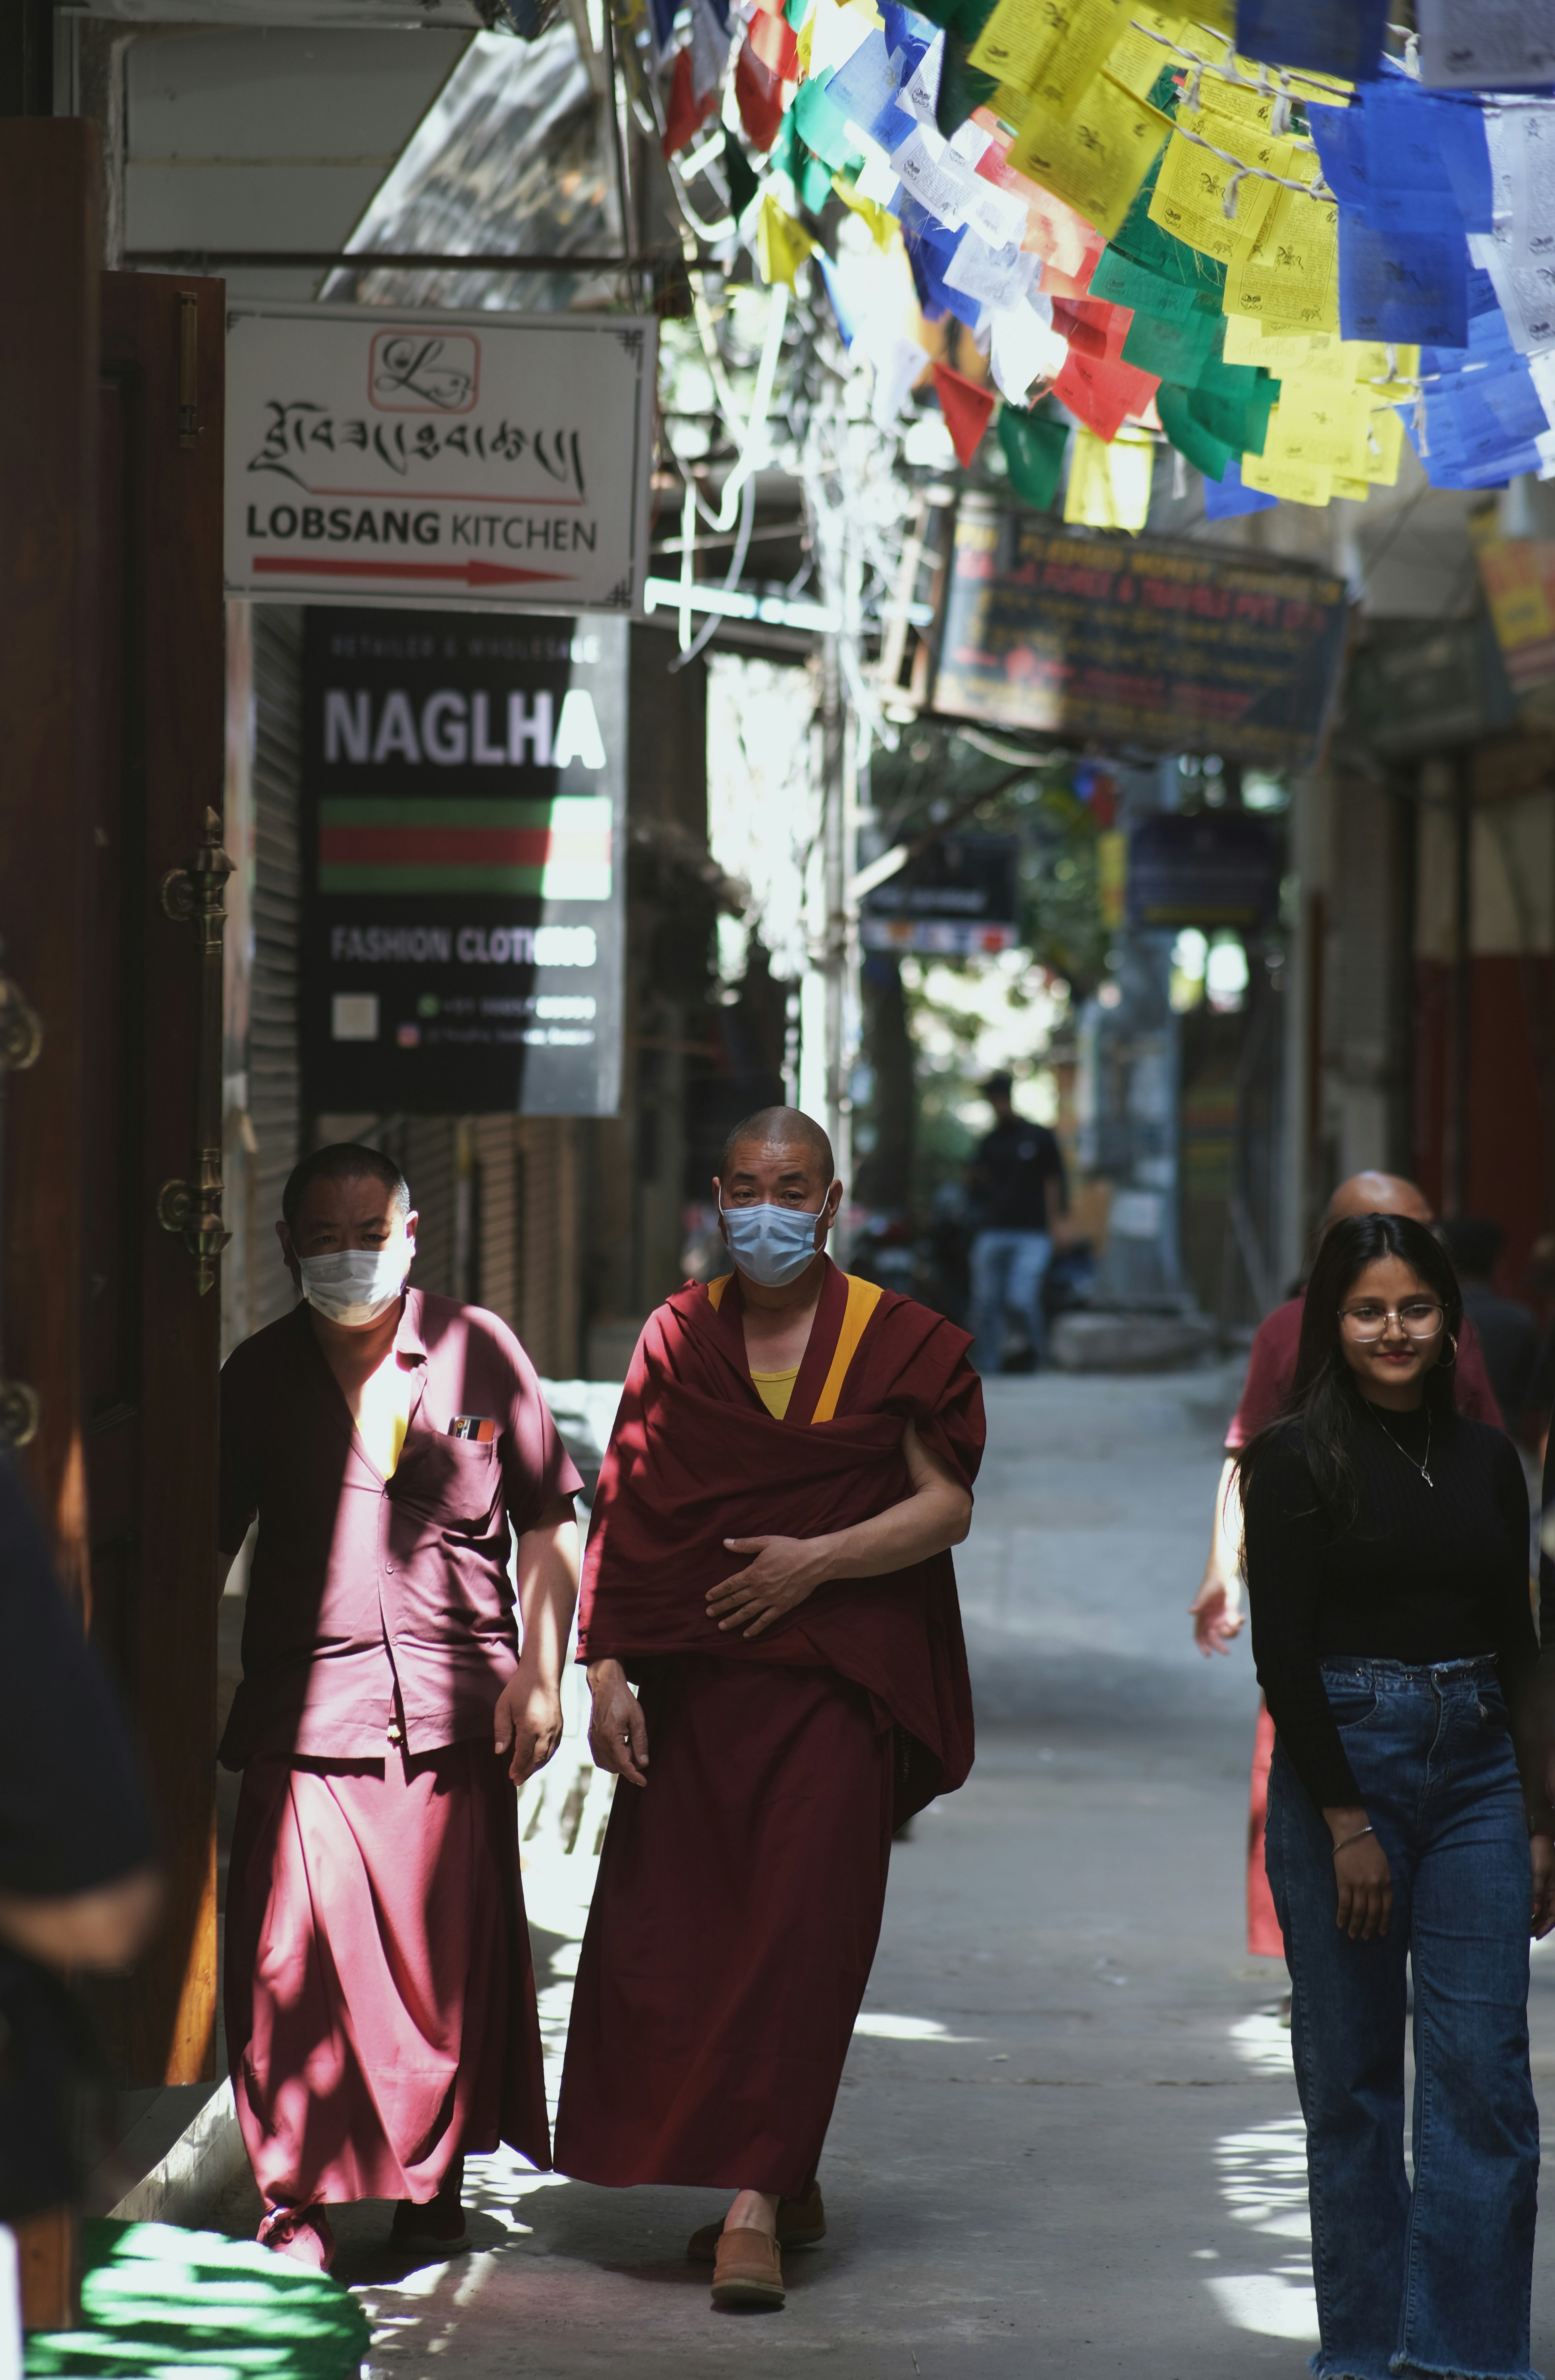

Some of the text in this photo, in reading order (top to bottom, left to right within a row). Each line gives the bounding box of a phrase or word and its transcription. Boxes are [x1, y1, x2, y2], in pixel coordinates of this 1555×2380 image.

[247, 505, 596, 552] LOBSANG KITCHEN
[324, 687, 606, 768] NAGLHA
[331, 926, 450, 964] FASHION
